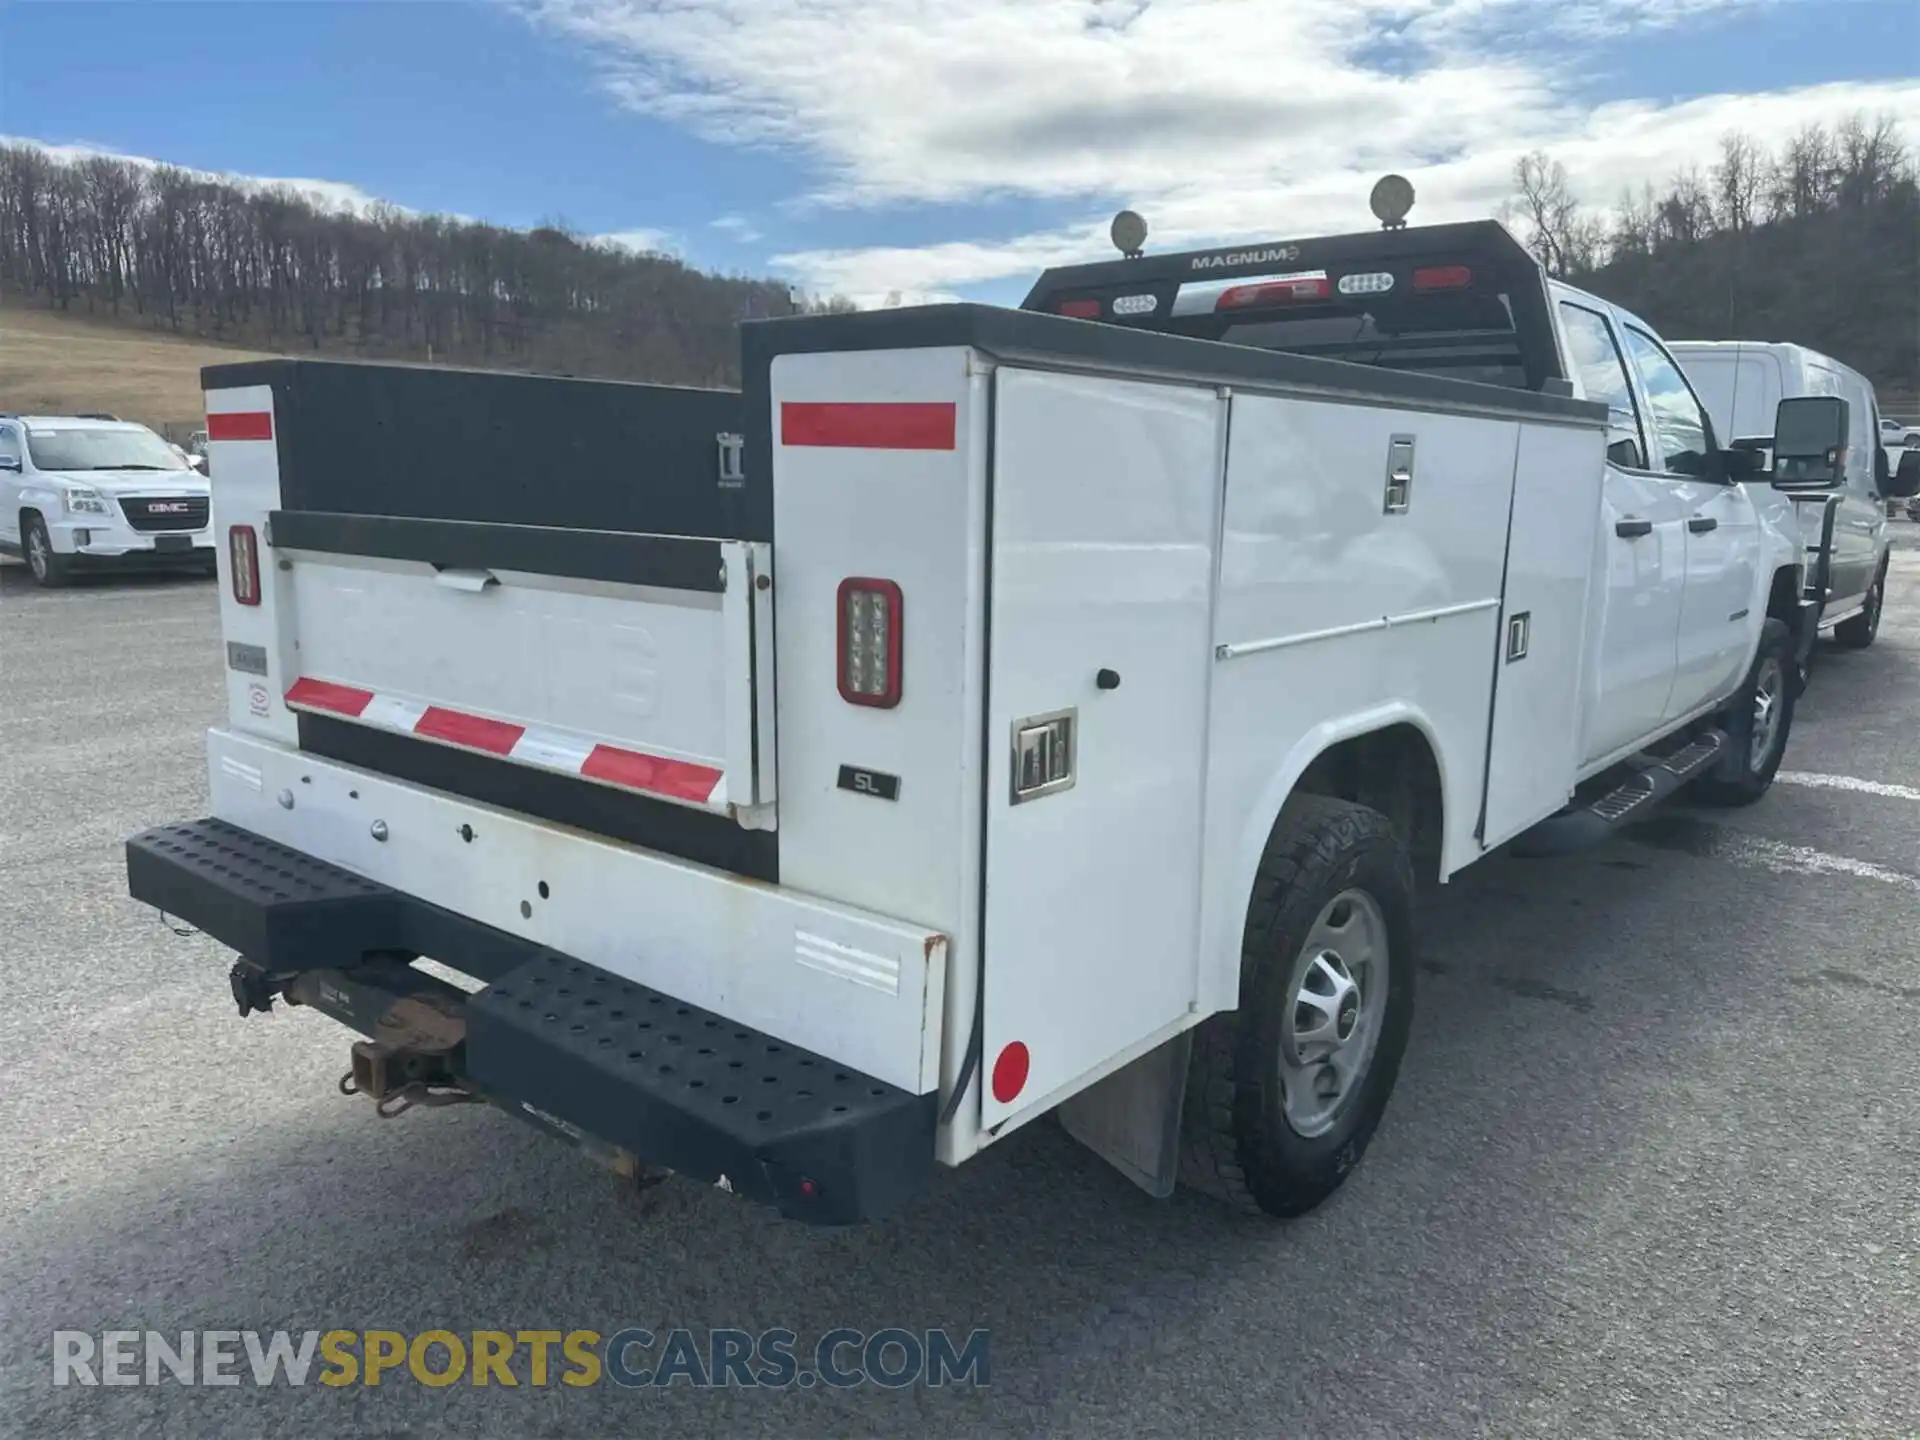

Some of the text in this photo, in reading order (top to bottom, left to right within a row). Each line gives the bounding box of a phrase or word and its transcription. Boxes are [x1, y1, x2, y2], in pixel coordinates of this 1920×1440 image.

[1191, 248, 1288, 270] MAGNUM
[148, 503, 189, 513] GMC
[854, 772, 880, 793] SL
